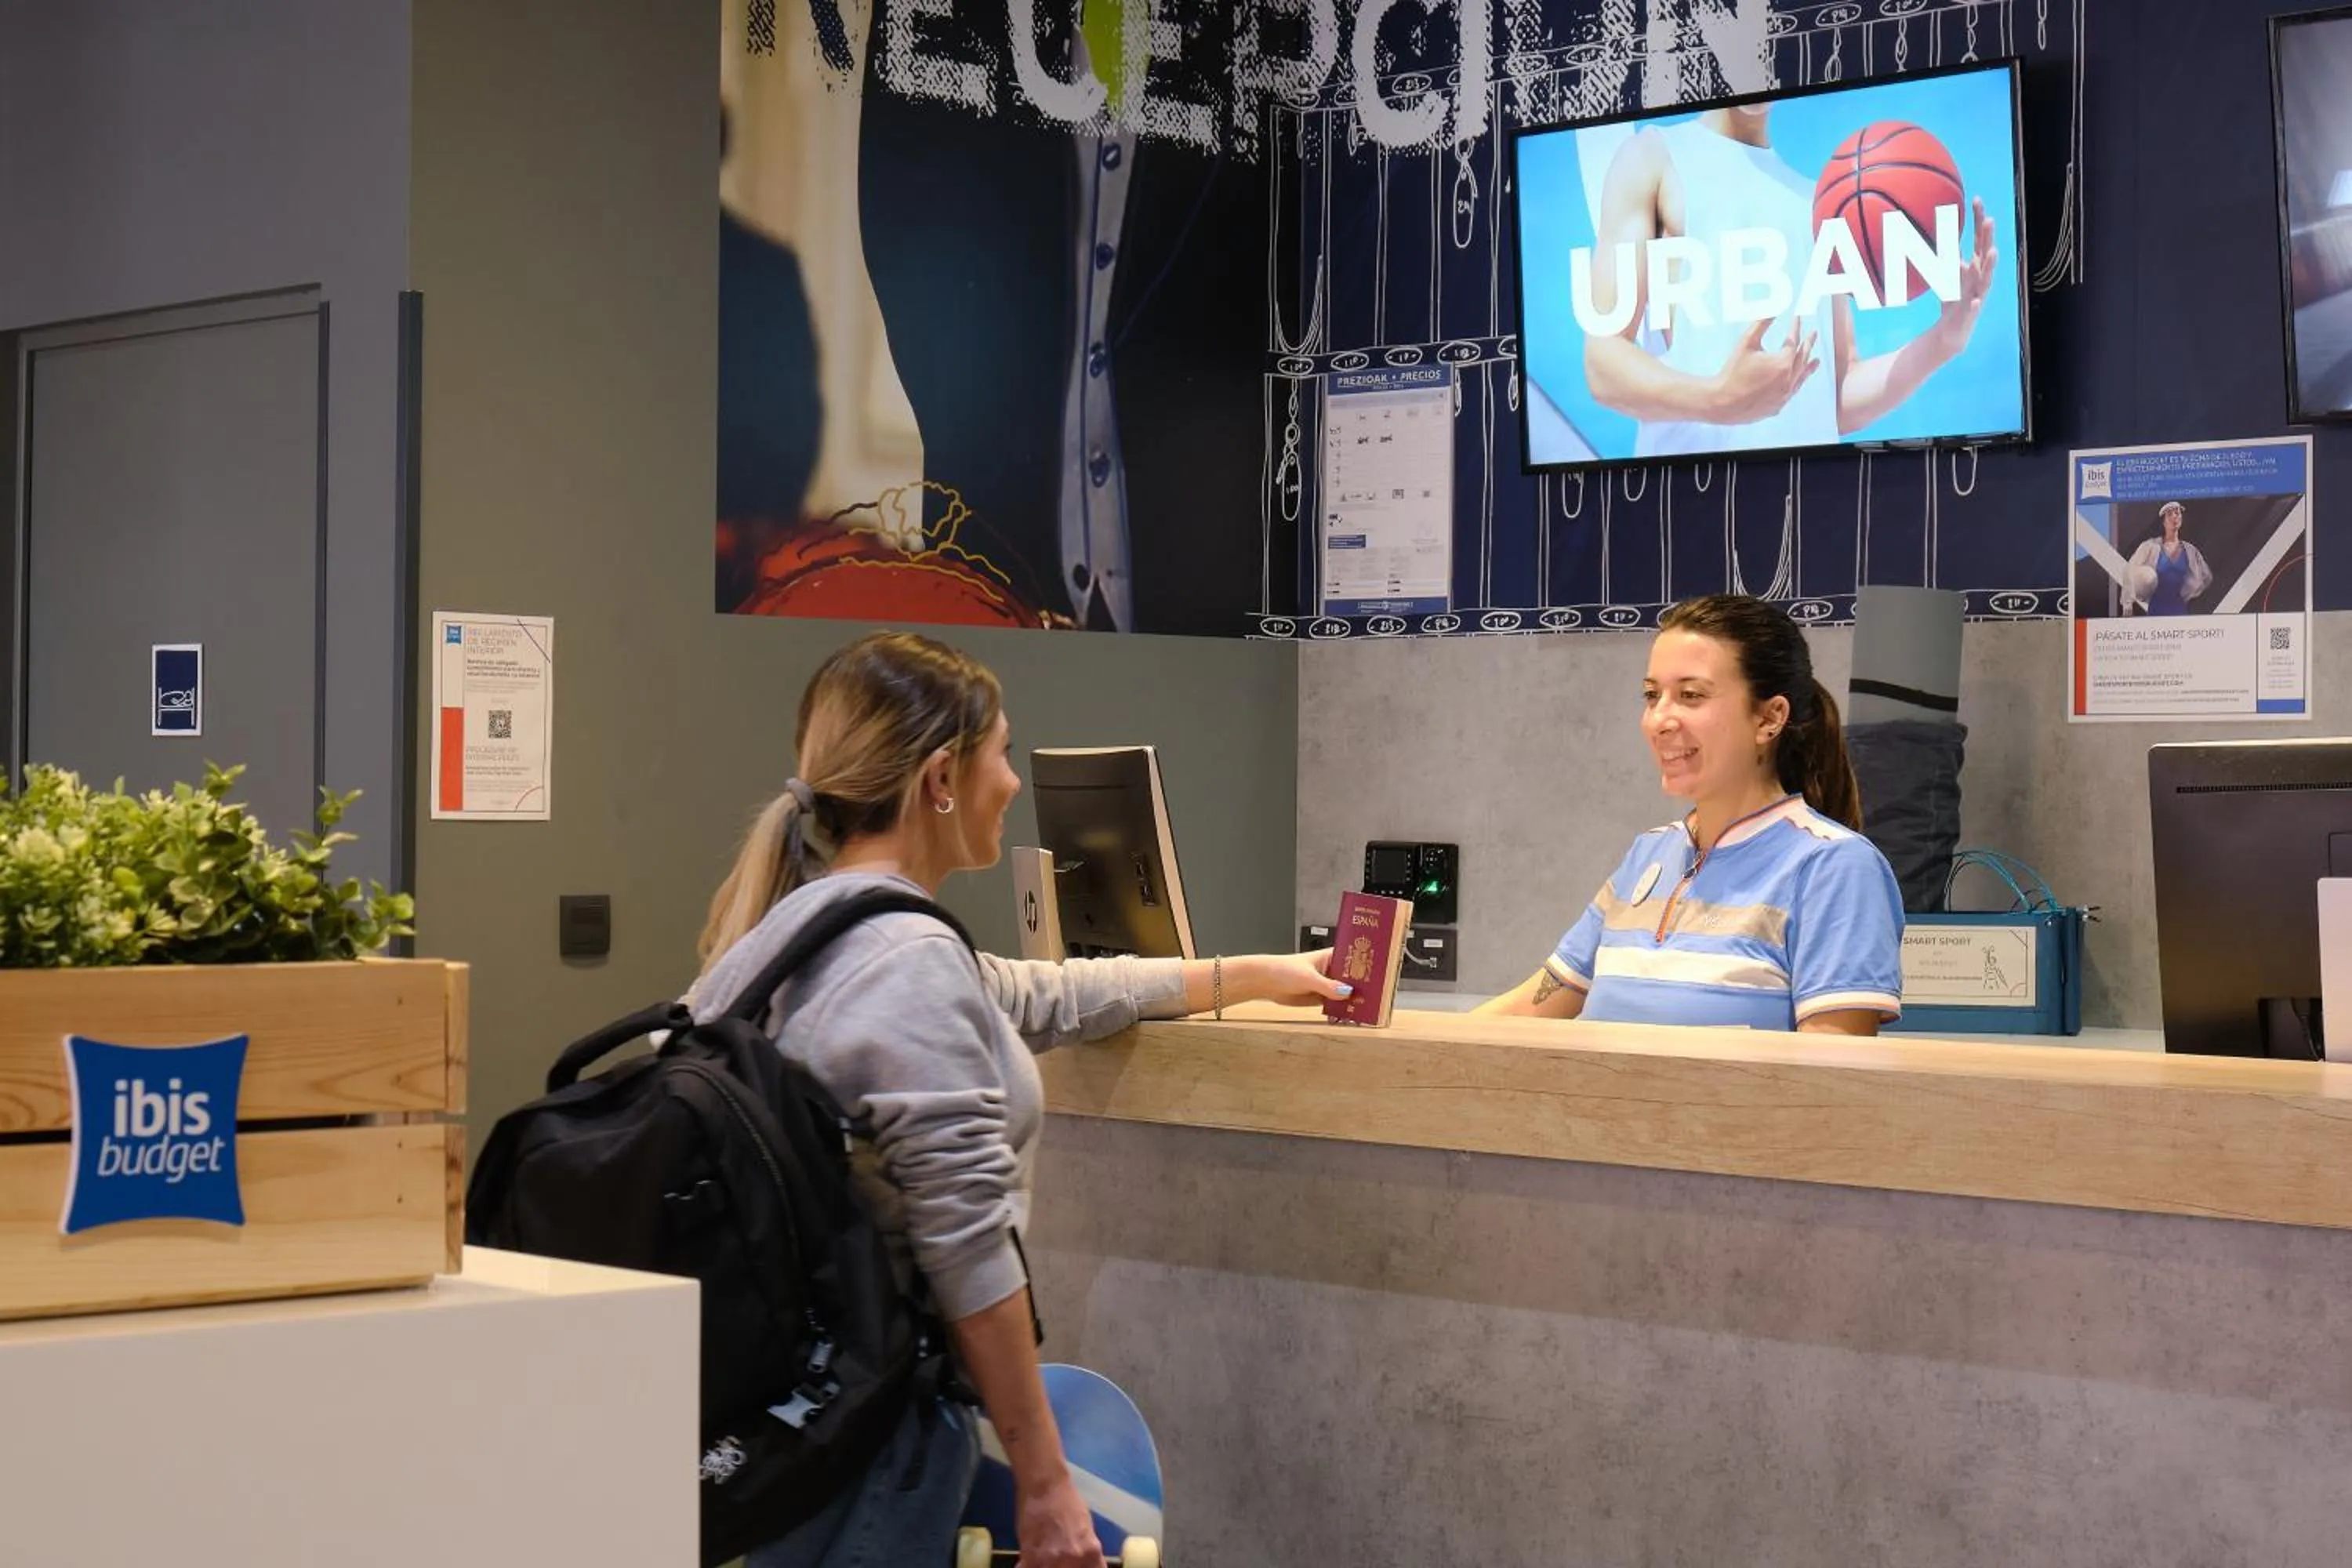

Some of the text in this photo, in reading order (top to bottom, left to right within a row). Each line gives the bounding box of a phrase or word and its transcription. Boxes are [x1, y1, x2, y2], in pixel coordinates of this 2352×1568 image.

[1570, 203, 1961, 337] URBAN
[1399, 369, 1443, 382] PRECIOS
[2087, 469, 2106, 481] ibis
[114, 1078, 211, 1138] ibis
[96, 1134, 226, 1184] budget
